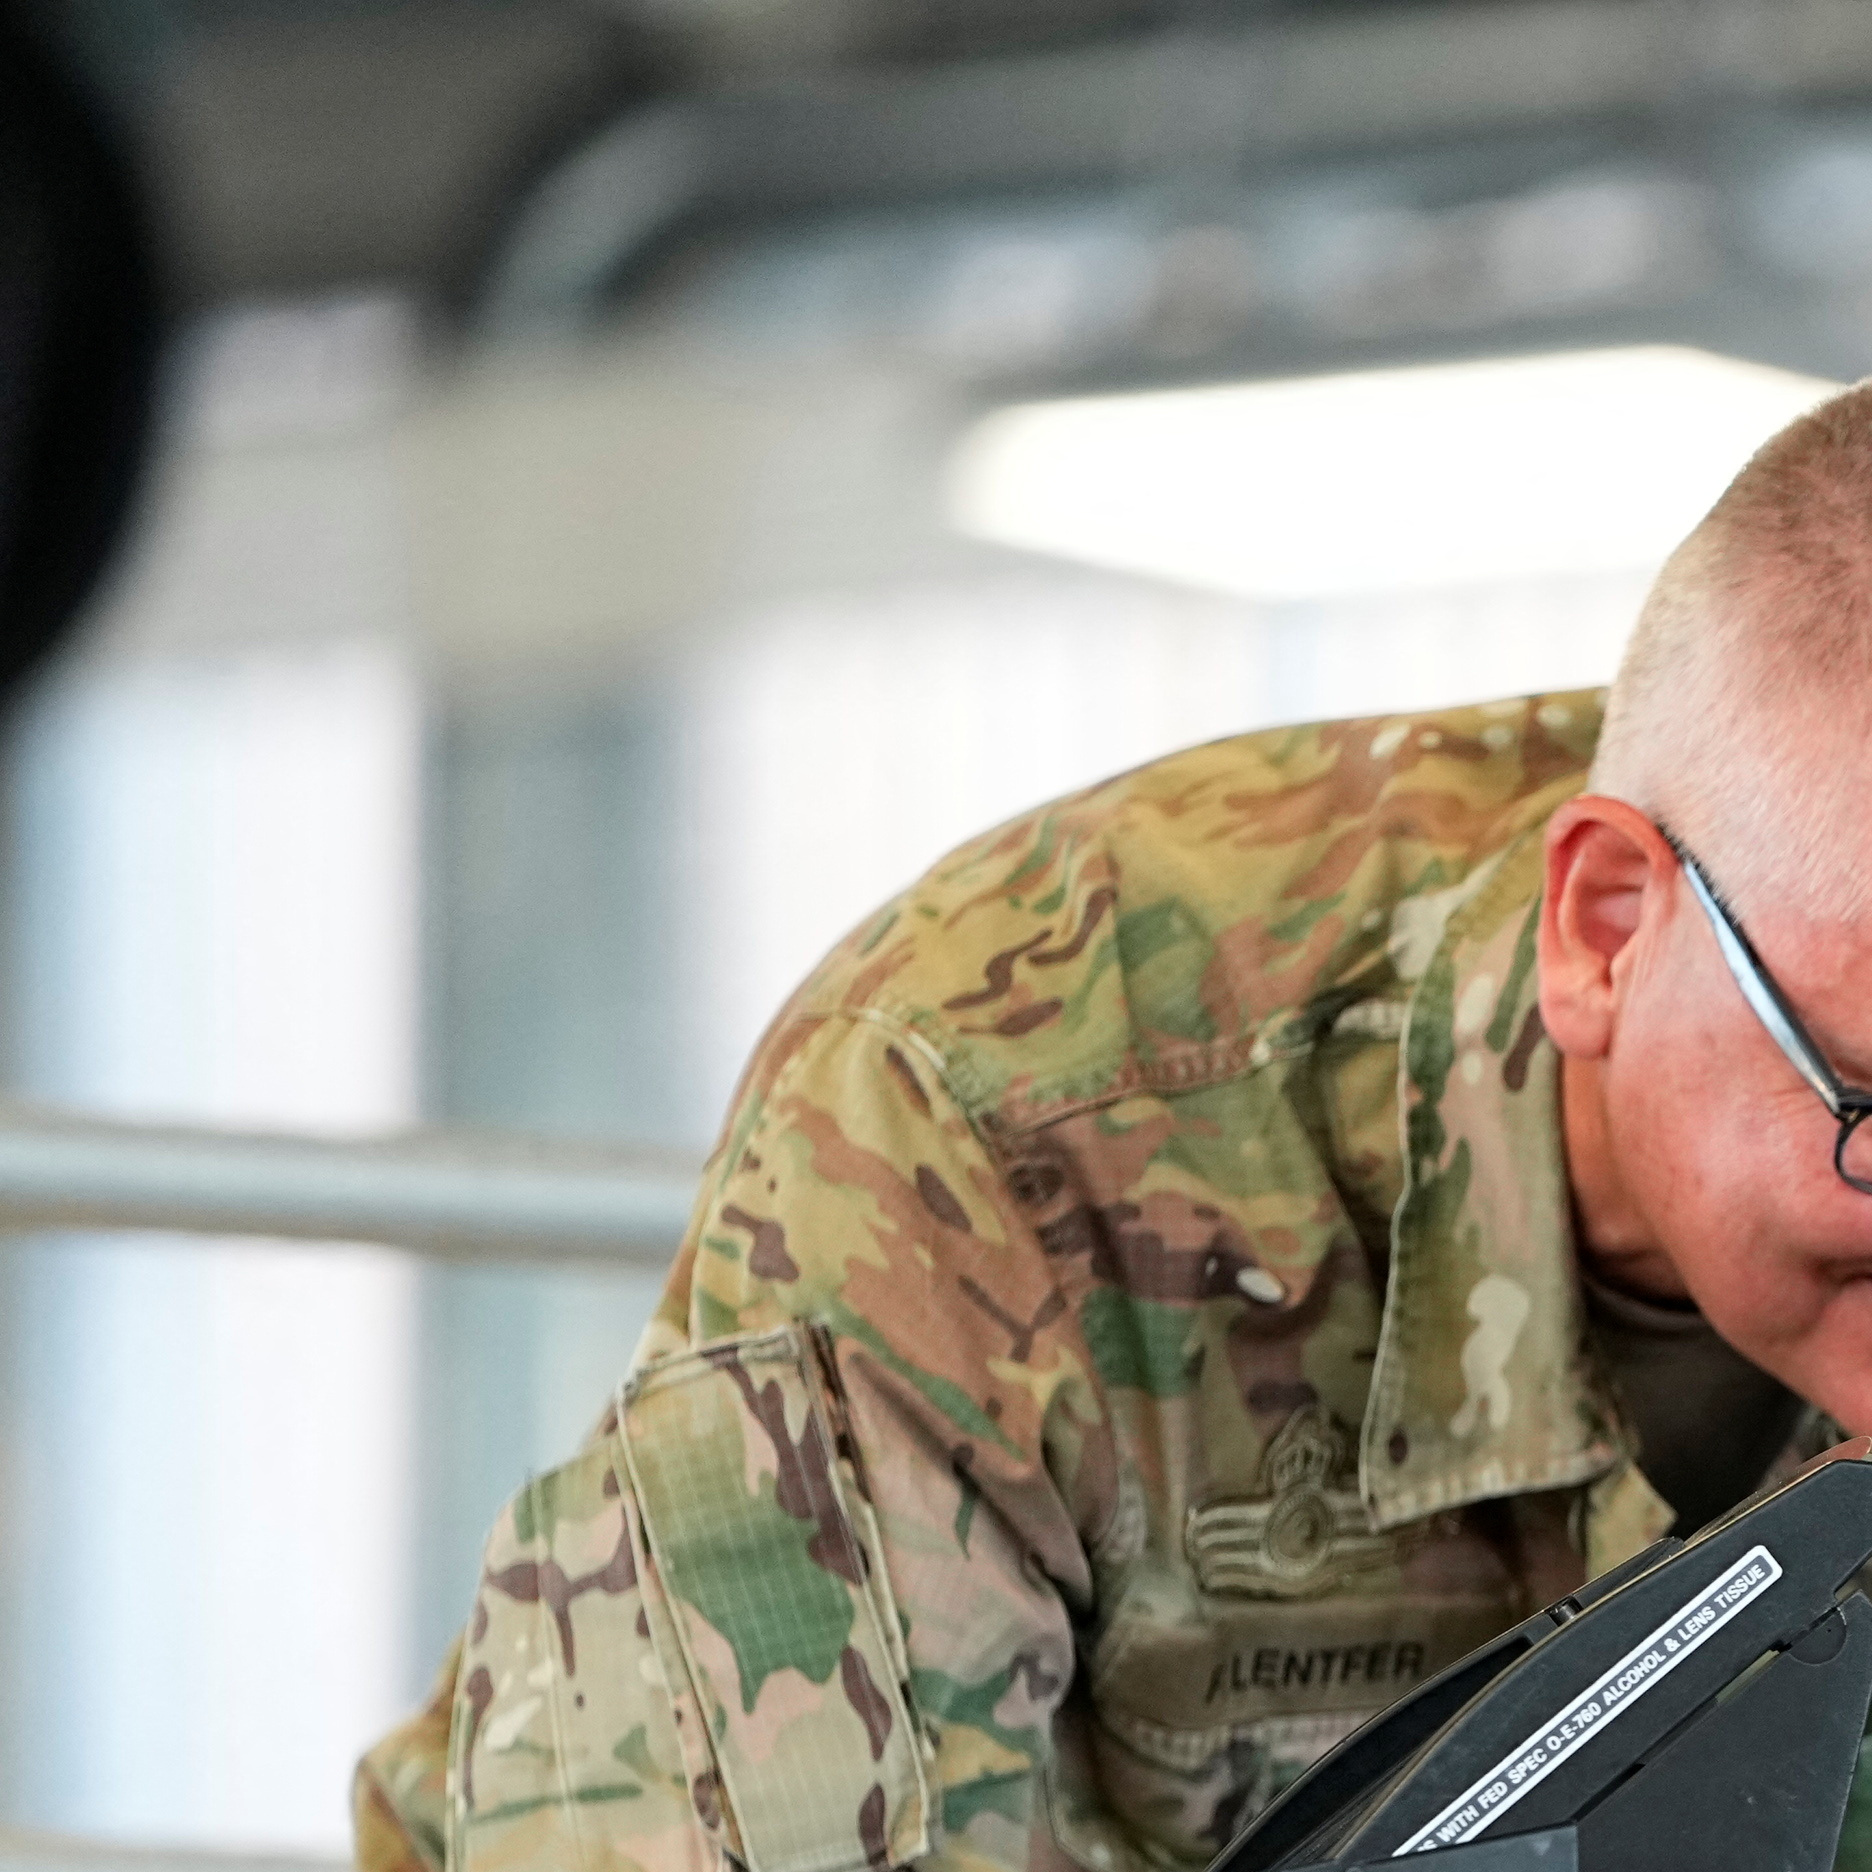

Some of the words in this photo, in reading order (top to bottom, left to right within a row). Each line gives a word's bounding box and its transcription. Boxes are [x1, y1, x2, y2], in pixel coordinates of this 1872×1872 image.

[1436, 1804, 1480, 1844] WITH
[1477, 1781, 1509, 1810] FED
[1507, 1748, 1548, 1785] SPEC
[1546, 1702, 1602, 1751] O-E-760
[1602, 1650, 1667, 1706] ALCOHOL
[1663, 1637, 1681, 1652] &
[1677, 1605, 1716, 1641] LENS
[1713, 1564, 1766, 1609] TISSUE
